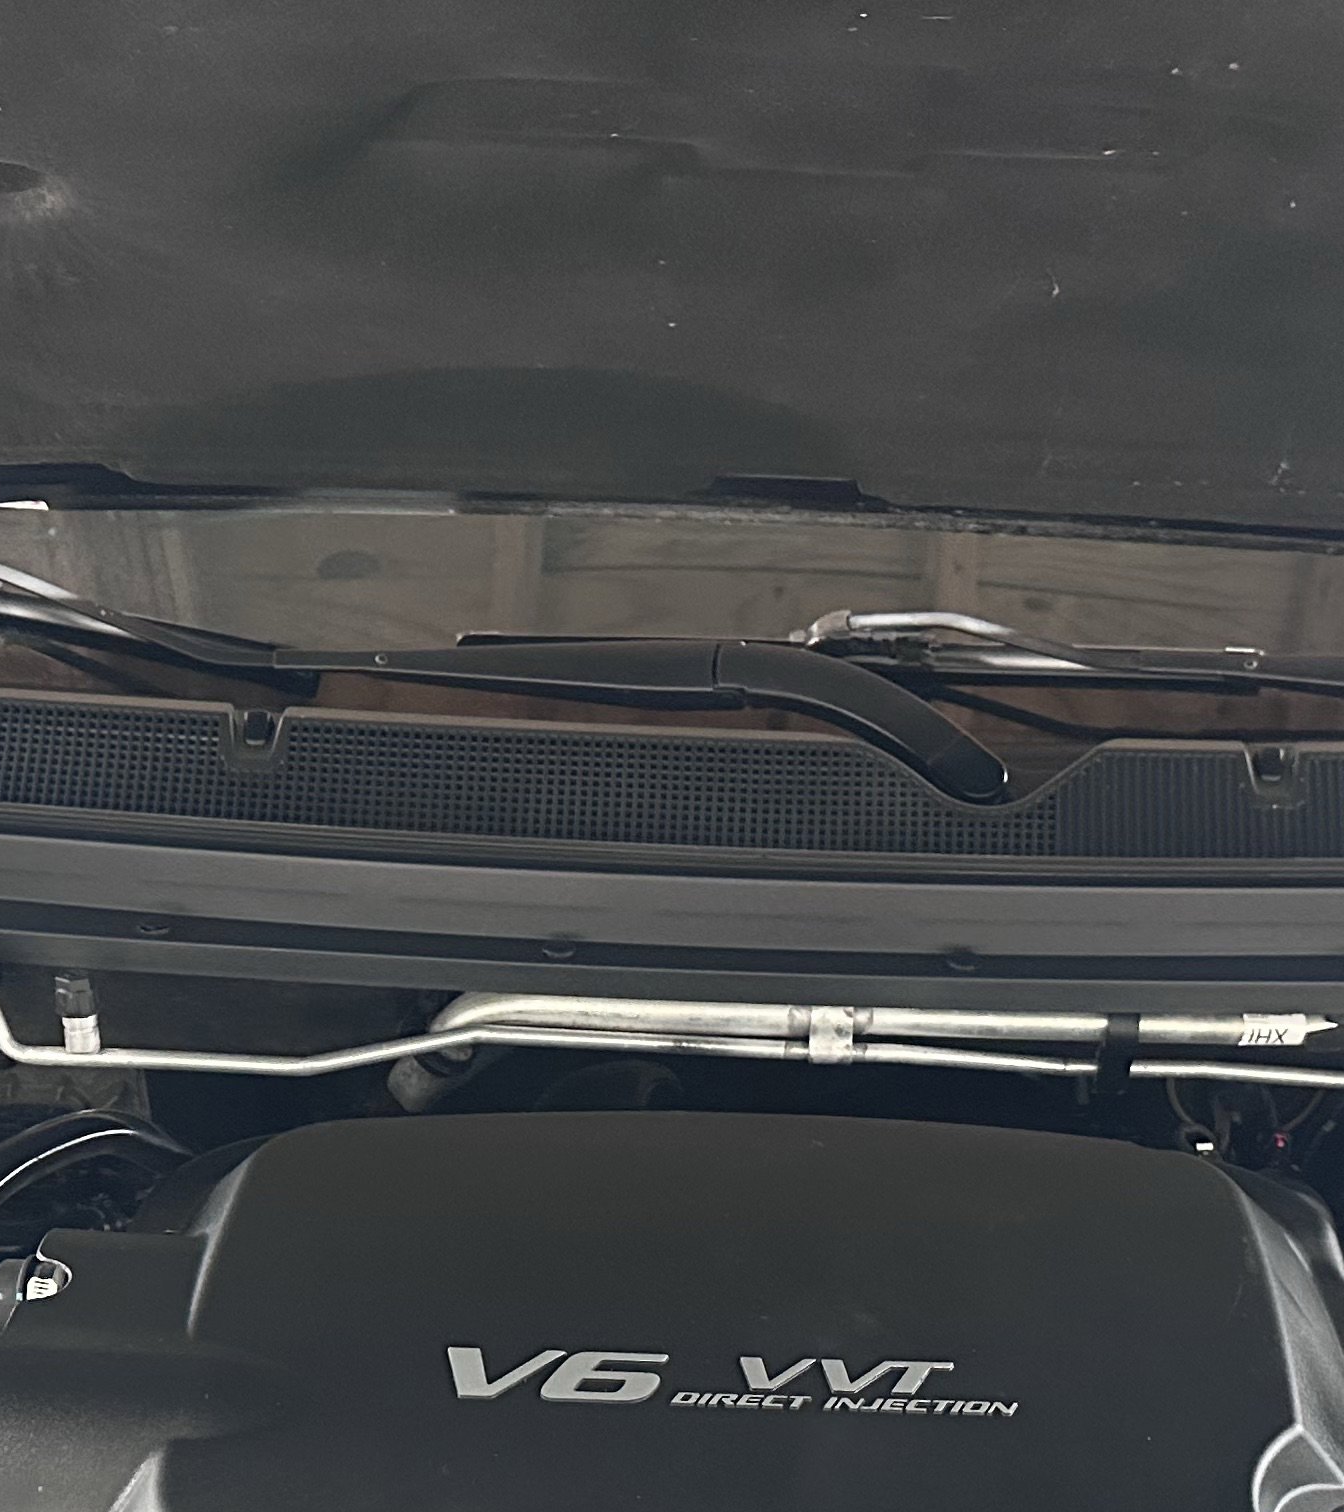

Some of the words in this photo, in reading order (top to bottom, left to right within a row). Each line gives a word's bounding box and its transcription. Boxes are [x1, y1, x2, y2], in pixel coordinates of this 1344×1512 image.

[447, 1346, 669, 1404] V6
[740, 1356, 954, 1395] VVT
[669, 1391, 813, 1410] DIRECT
[823, 1396, 1019, 1417] INJECTION
